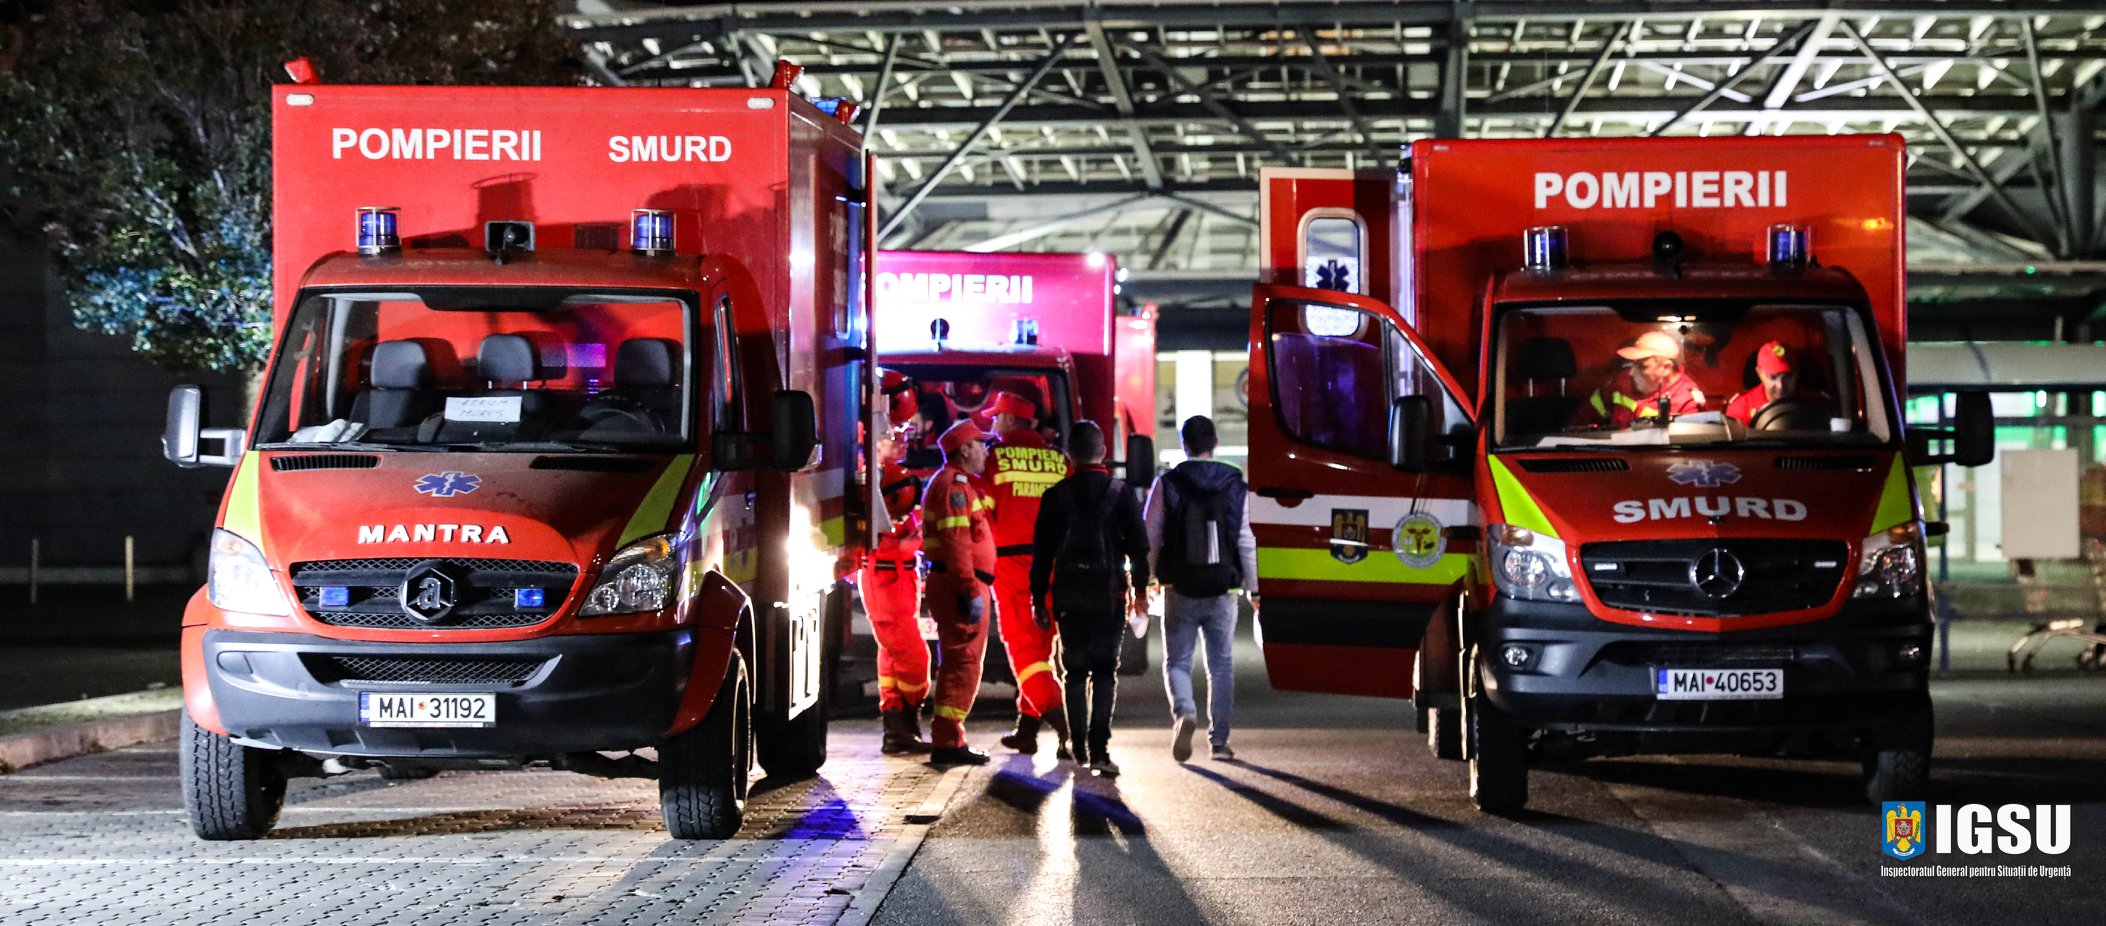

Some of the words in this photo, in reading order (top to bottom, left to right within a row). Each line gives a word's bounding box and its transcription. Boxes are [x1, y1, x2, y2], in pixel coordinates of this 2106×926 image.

[331, 127, 541, 161] POMPIERII
[608, 135, 733, 162] SMURD
[1534, 170, 1788, 209] POMPIERII
[875, 271, 1034, 304] OMPIERII
[997, 458, 1067, 477] SMURD
[1012, 481, 1056, 498] PARAM
[1612, 496, 1808, 523] SMURD
[357, 524, 512, 545] MANTRA
[1674, 672, 1705, 692] MAI
[1714, 672, 1777, 692] 40653
[379, 697, 414, 718] MAI
[429, 697, 486, 718] 31192
